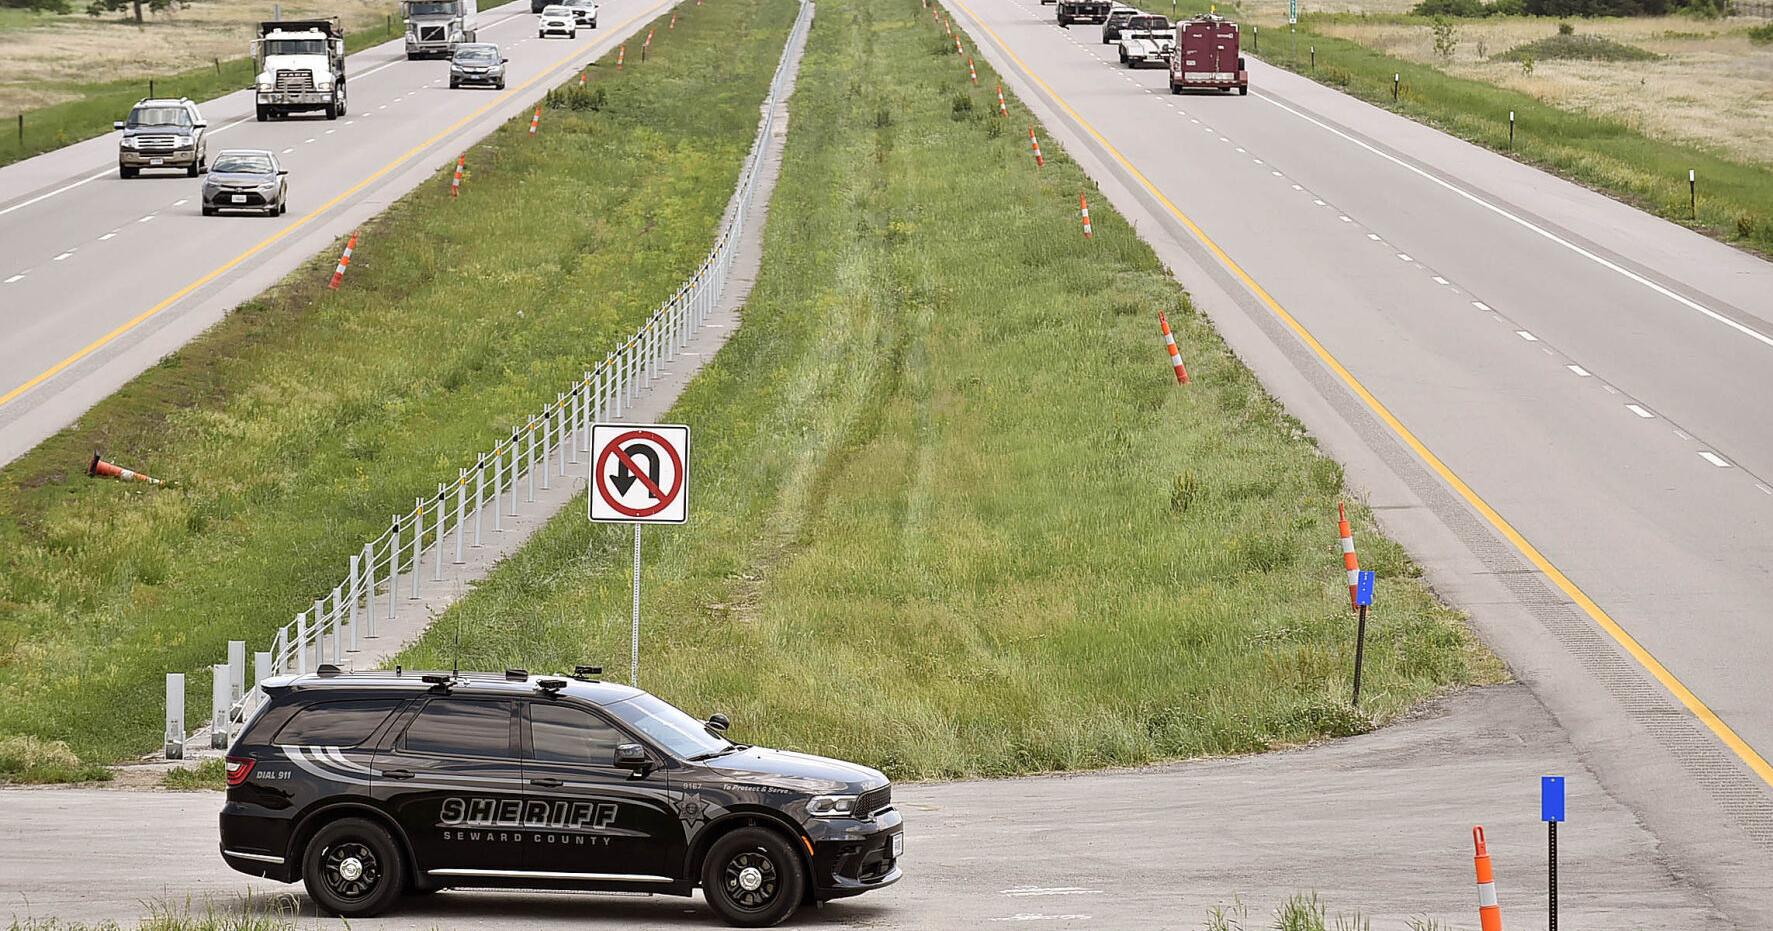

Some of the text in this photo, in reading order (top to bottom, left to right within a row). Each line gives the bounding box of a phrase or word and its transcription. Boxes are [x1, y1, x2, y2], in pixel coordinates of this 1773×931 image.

[256, 771, 292, 779] DIAL 911
[731, 784, 760, 792] Protect
[440, 797, 618, 829] SHERIFF
[443, 831, 611, 846] SEWARD COUNTY
